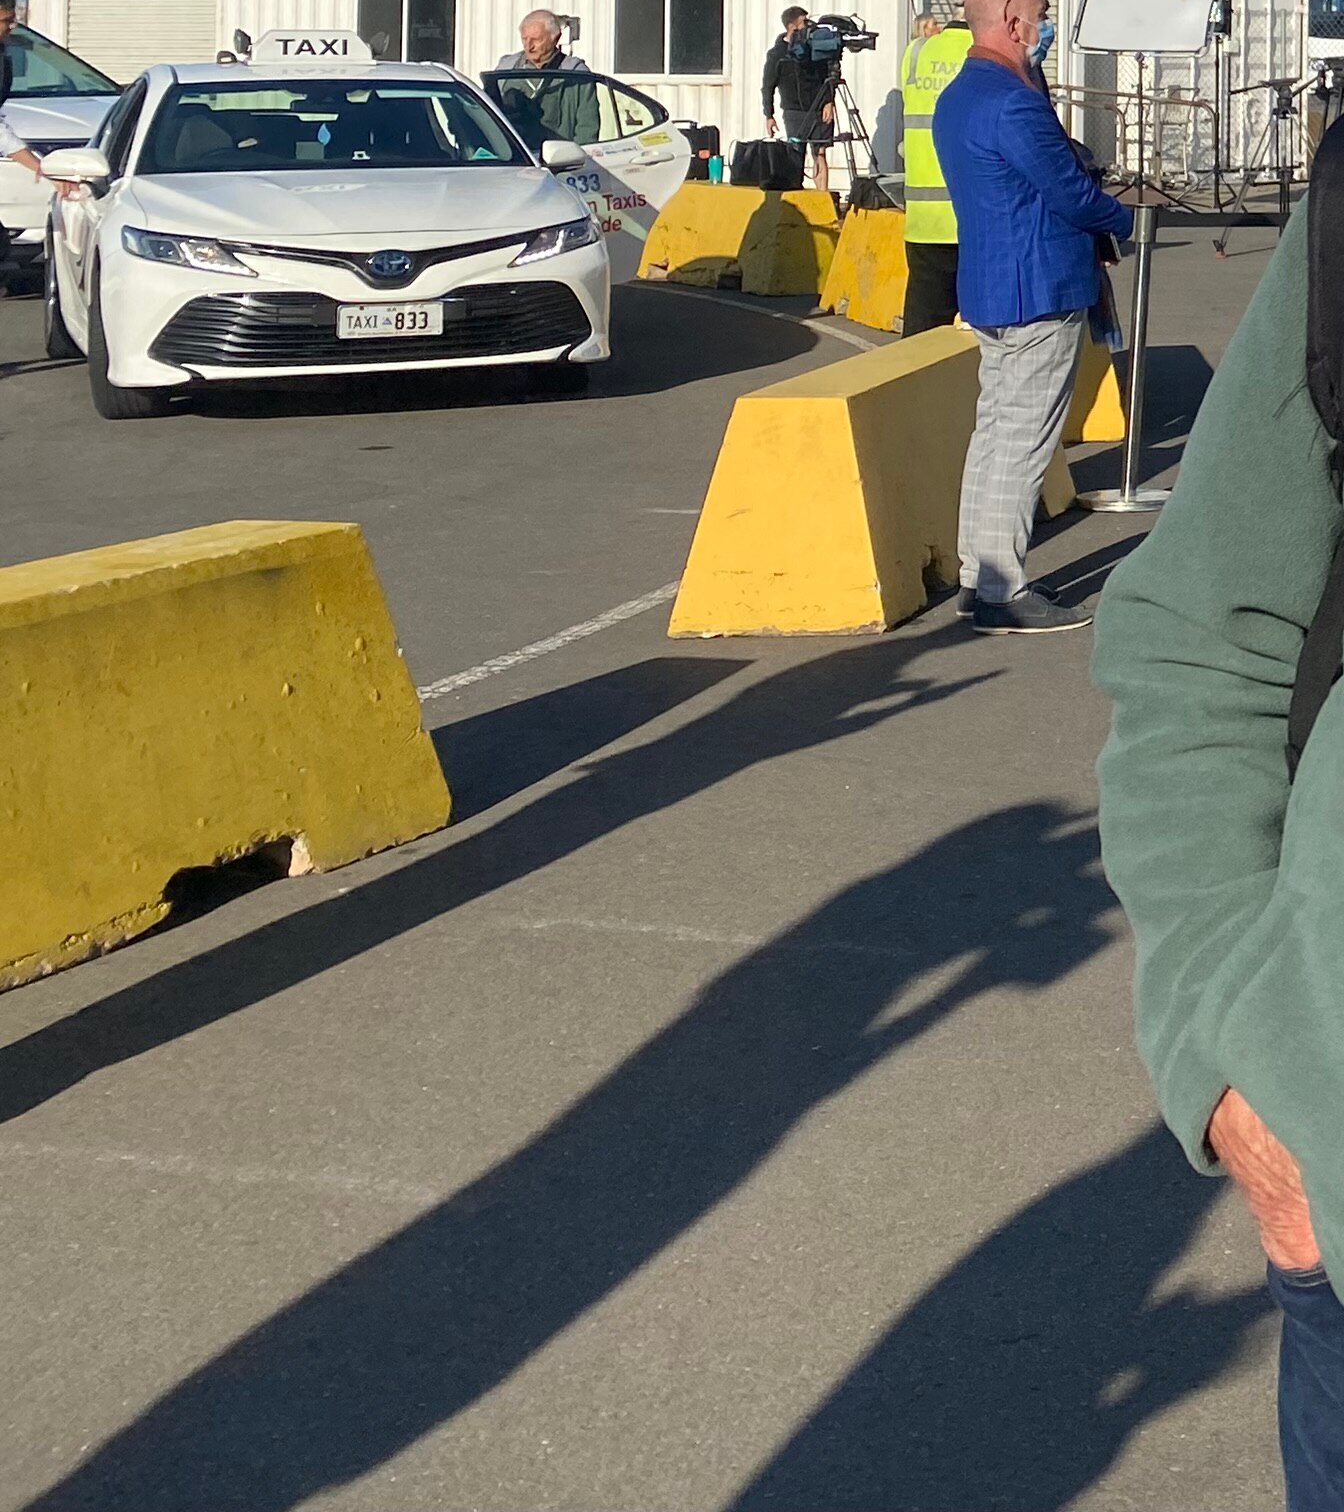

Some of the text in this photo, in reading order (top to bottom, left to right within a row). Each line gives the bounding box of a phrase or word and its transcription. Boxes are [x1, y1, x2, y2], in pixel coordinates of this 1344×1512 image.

[275, 38, 348, 56] TAXI
[930, 60, 961, 76] TAX
[602, 191, 647, 211] Taxis
[346, 311, 428, 330] TAXI 833
